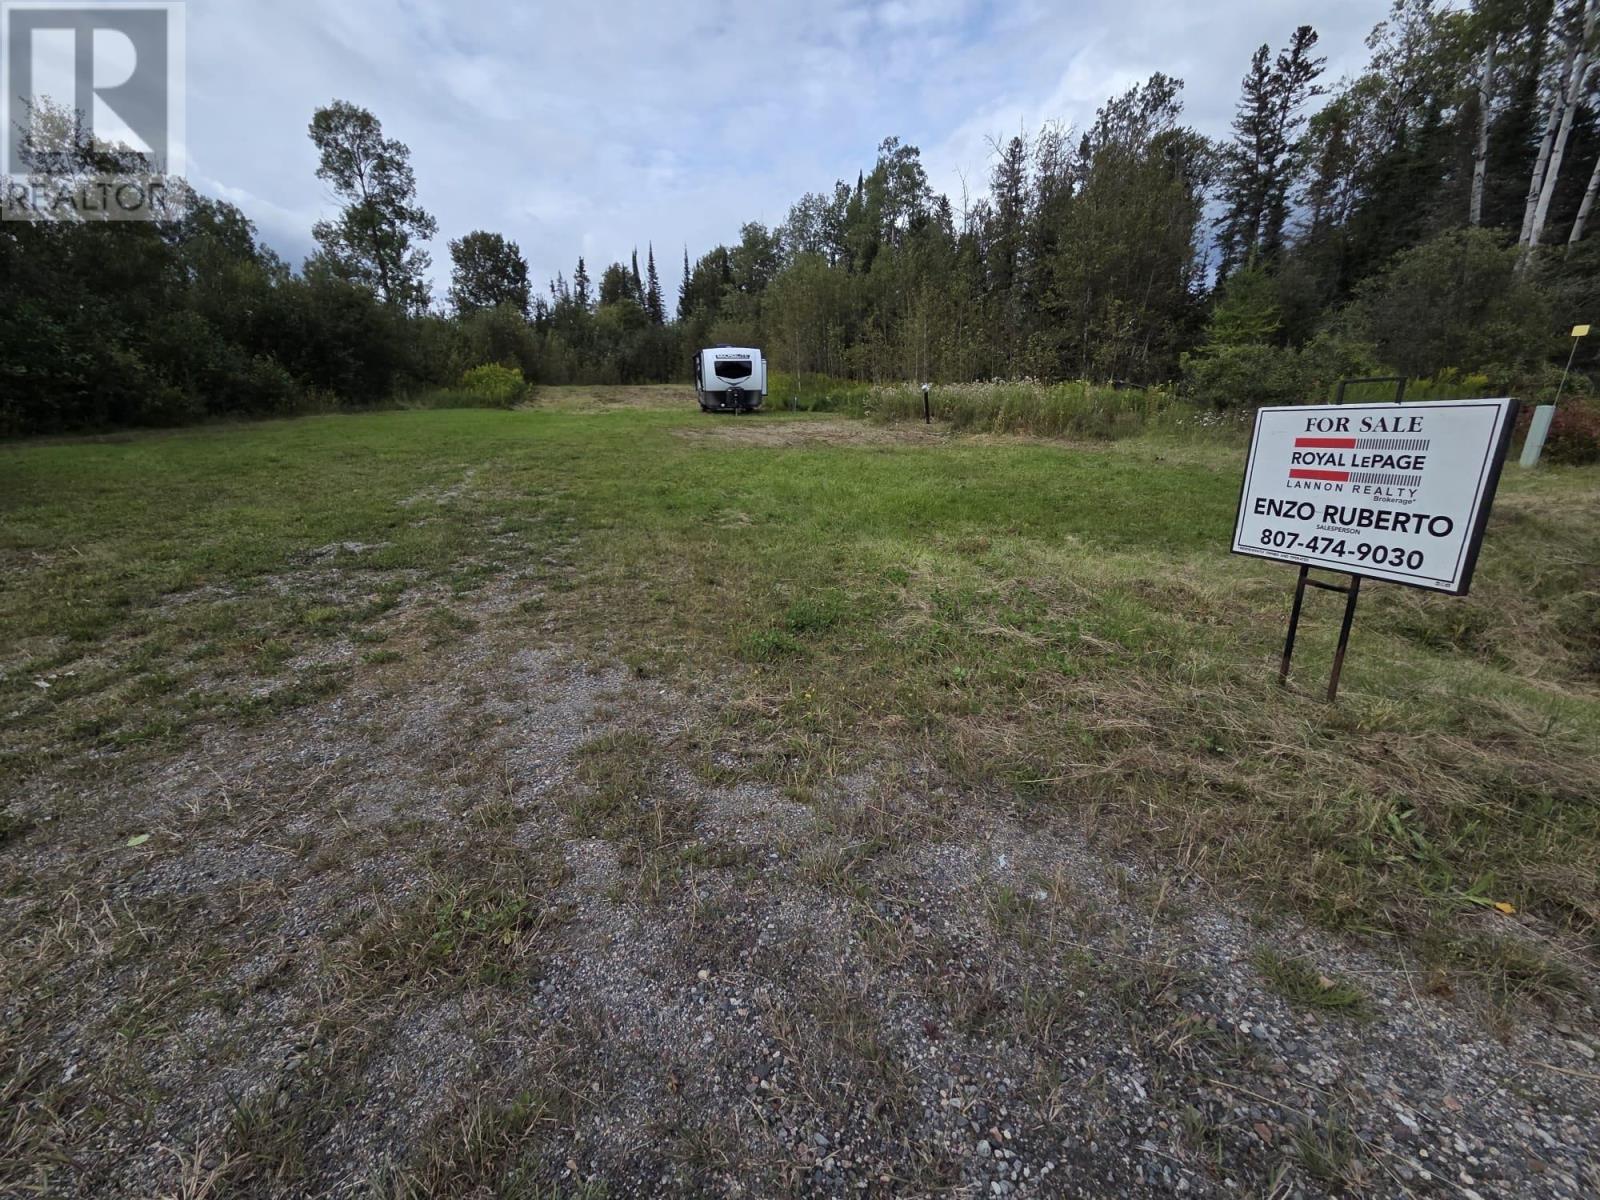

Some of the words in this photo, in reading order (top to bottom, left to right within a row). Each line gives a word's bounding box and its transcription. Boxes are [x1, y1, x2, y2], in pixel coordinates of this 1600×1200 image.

[1305, 417, 1350, 433] FOR
[1359, 416, 1424, 433] SALE
[1291, 452, 1346, 467] ROYAL
[1286, 480, 1344, 492] LANNON
[1352, 485, 1419, 498] REALTY
[1254, 497, 1316, 520] ENZO
[1322, 505, 1454, 537] RUBERTO
[1316, 524, 1361, 535] SALESPERSON
[1260, 529, 1424, 570] 807-474-9030
